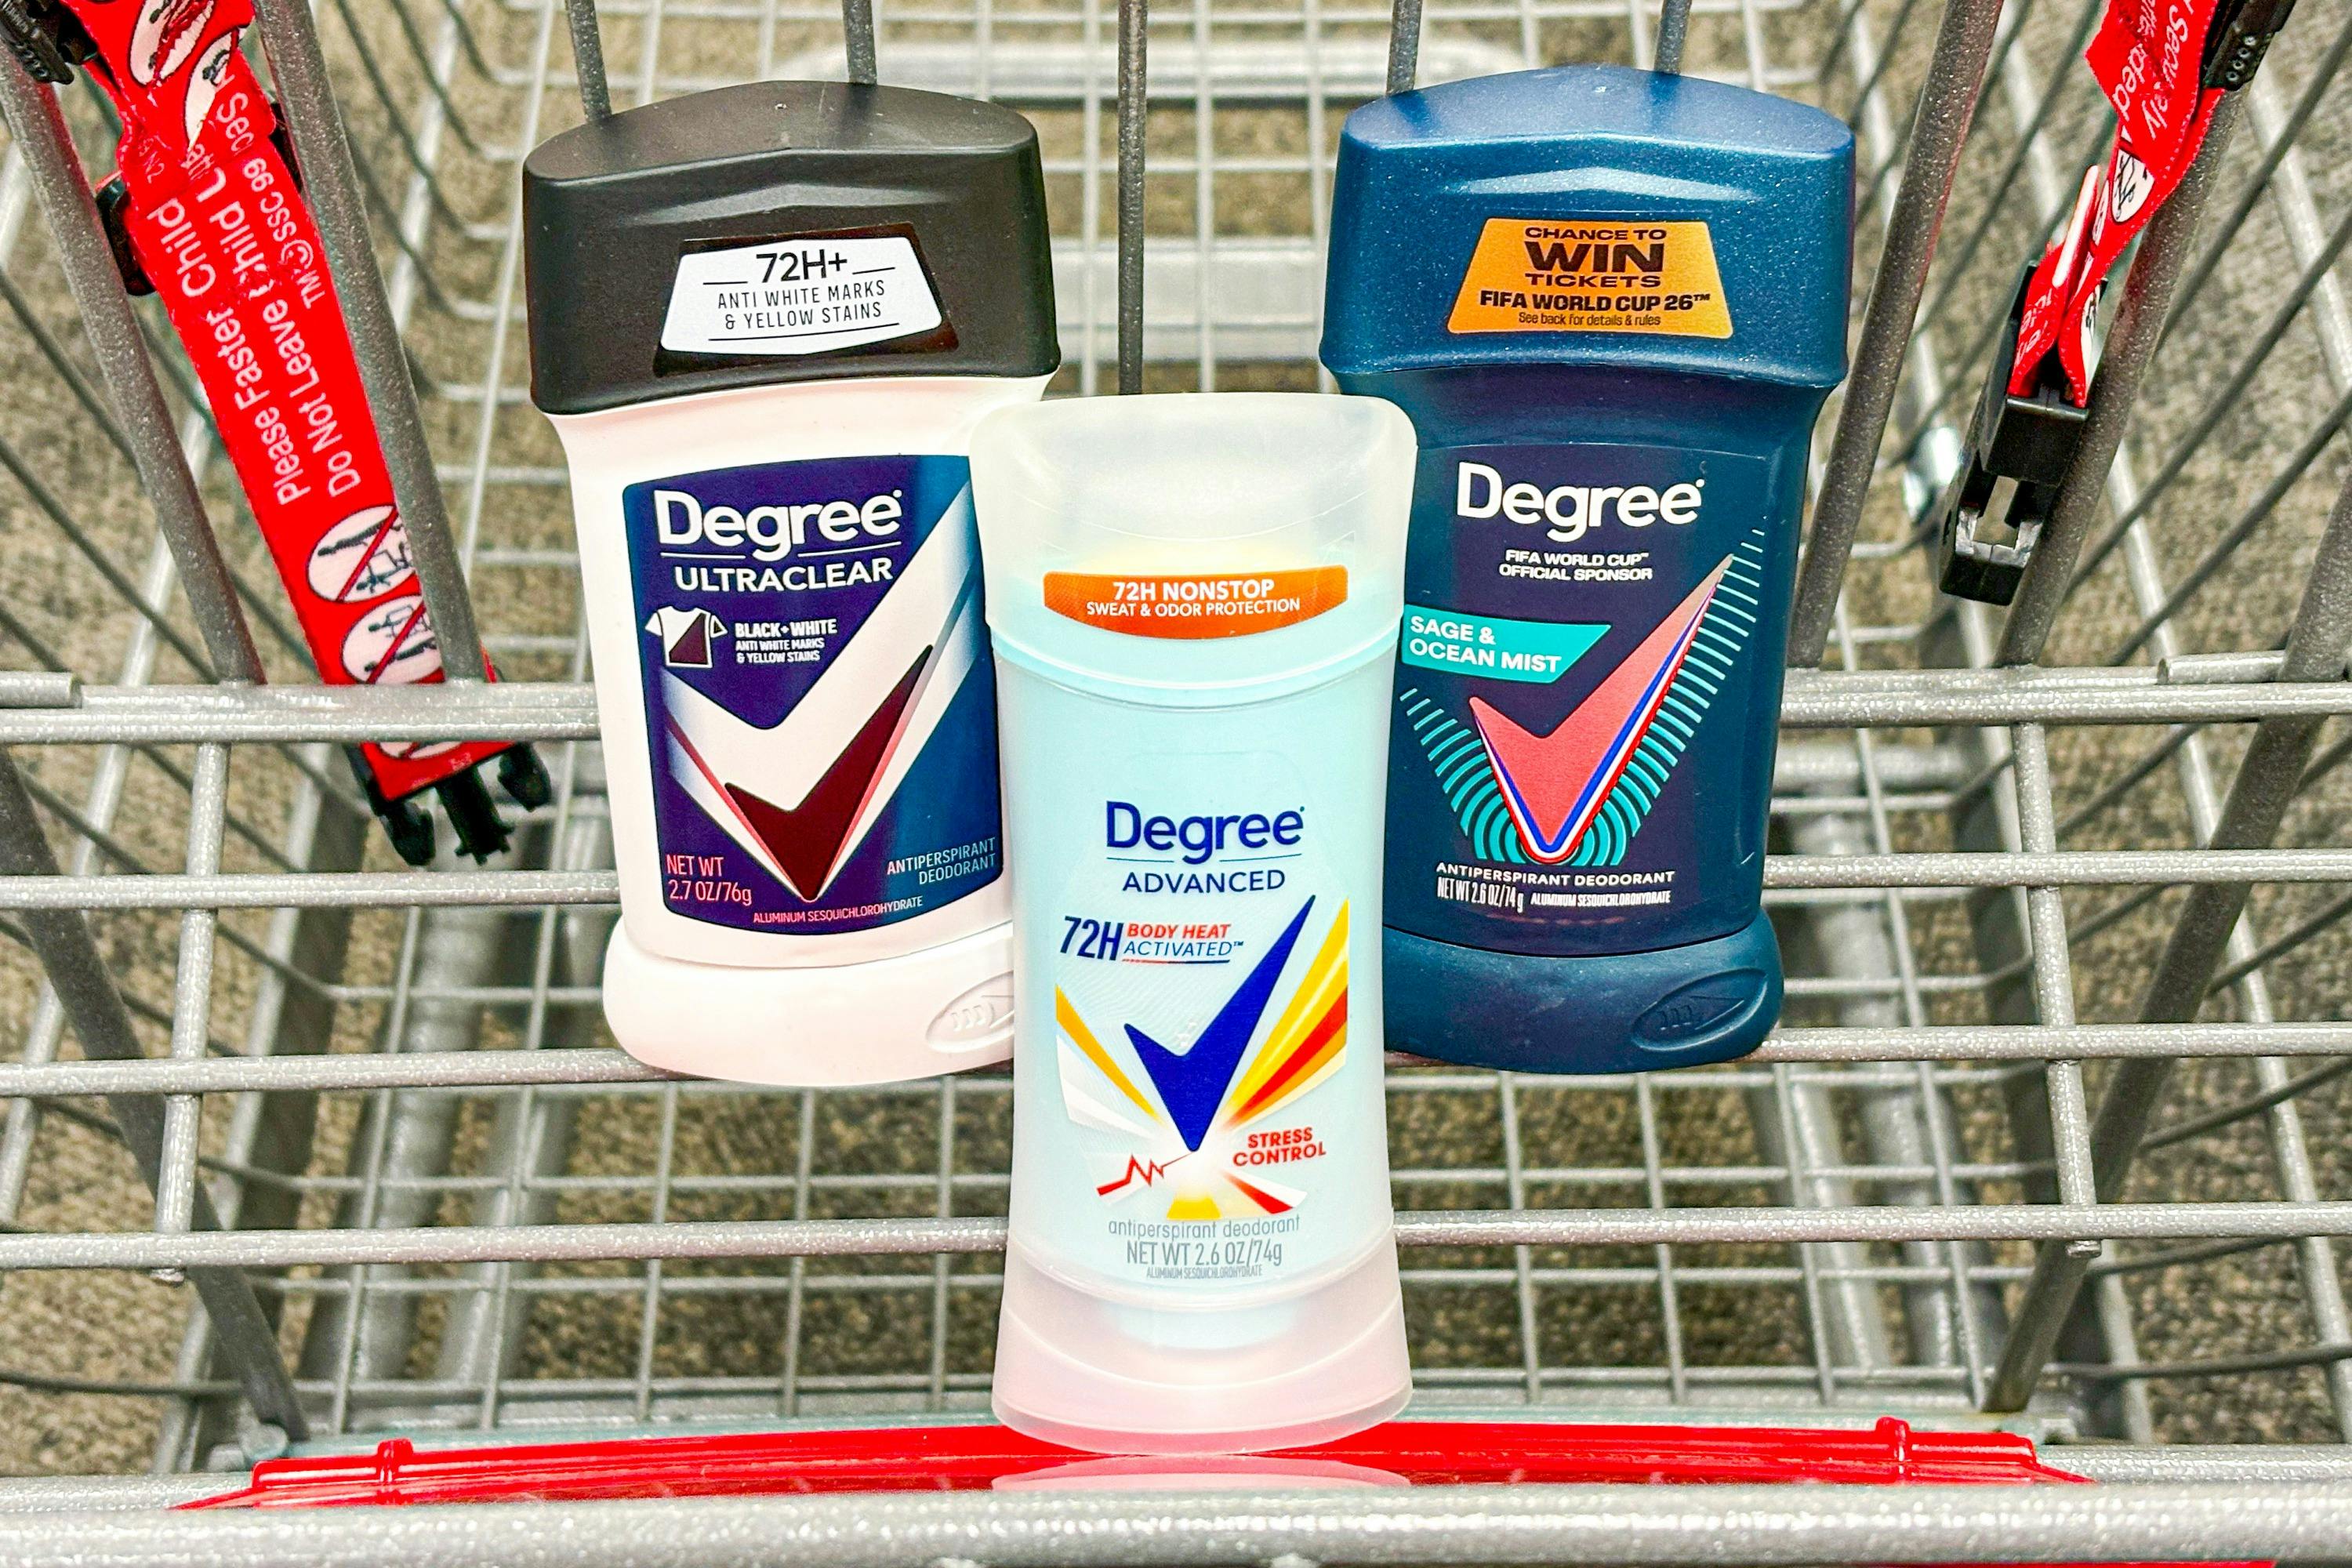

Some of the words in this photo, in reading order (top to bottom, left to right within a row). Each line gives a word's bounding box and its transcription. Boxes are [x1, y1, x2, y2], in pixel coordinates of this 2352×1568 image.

[242, 157, 274, 193] 99
[260, 191, 297, 242] SSC
[146, 197, 216, 297] Child
[1525, 227, 1628, 240] CHANCE
[1635, 229, 1667, 240] TO
[757, 249, 848, 283] 72H+
[1524, 241, 1665, 273] WIN
[717, 292, 757, 310] ANTI
[765, 287, 820, 307] WHITE
[828, 280, 885, 302] MARKS
[1524, 273, 1661, 289] TICKETS
[1480, 290, 1531, 309] FIFA
[1533, 296, 1610, 311] WORLD
[1615, 296, 1661, 312] CUP
[725, 314, 735, 329] &
[744, 310, 813, 328] YELLOW
[822, 302, 881, 324] STAINS
[1519, 312, 1540, 324] See
[1541, 314, 1566, 325] back
[1569, 314, 1584, 326] for
[1587, 314, 1622, 326] details
[1624, 314, 1632, 326] &
[1635, 314, 1661, 326] rules
[263, 299, 320, 397] Leave
[298, 393, 343, 453] Not
[254, 406, 311, 506] Please
[327, 450, 361, 497] Do
[1457, 461, 1705, 543] Degree
[654, 490, 902, 561] Degree
[1505, 549, 1541, 564] FIFA
[1544, 553, 1604, 566] WORLD
[675, 557, 893, 591] ULTRACLEAR
[1499, 564, 1570, 581] OFFICIAL
[1574, 567, 1653, 582] SPONSOR
[1113, 582, 1156, 601] 72H
[1163, 579, 1275, 601] NONSTOP
[1087, 601, 1134, 616] SWEAT
[1141, 604, 1150, 616] &
[1155, 602, 1202, 616] ODOR
[1207, 597, 1301, 615] PROTECTION
[1410, 615, 1474, 643] SAGE
[1479, 627, 1496, 644] &
[736, 640, 757, 651] ANTI
[759, 640, 790, 651] WHITE
[792, 637, 825, 650] MARKS
[737, 652, 745, 663] &
[746, 652, 786, 663] YELLOW
[787, 650, 820, 662] STAINS
[1409, 637, 1496, 667] OCEAN
[1501, 651, 1562, 673] MIST
[1106, 800, 1305, 865] Degree
[666, 855, 694, 876] NET
[698, 857, 724, 877] WT
[887, 837, 996, 875] ANTIPERSPIRANT
[918, 853, 995, 885] DEODORANT
[1123, 869, 1286, 894] ADVANCED
[1436, 862, 1570, 886] ANTIPERSPIRANT
[1574, 871, 1675, 886] DEODORANT
[669, 880, 691, 900] 2.7
[695, 880, 753, 906] OZ/76g
[1437, 877, 1455, 899] NET
[1456, 880, 1471, 902] WT
[1471, 881, 1486, 904] 2.6
[753, 911, 806, 924] ALUMINUM
[807, 895, 923, 923] SESQUICHLOROHYDRATE
[1060, 916, 1124, 961] 72H
[1127, 924, 1178, 938] BODY
[1183, 924, 1231, 938] HEAT
[1247, 1127, 1313, 1149] STRESS
[1232, 1141, 1327, 1167] CONTROL
[1108, 1219, 1216, 1241] antiperspirant
[1223, 1214, 1300, 1238] deodorant
[1127, 1240, 1158, 1265] NET
[1161, 1242, 1190, 1266] WT
[1196, 1242, 1220, 1265] 2.6
[1225, 1238, 1282, 1267] OZ/74g
[1146, 1266, 1183, 1279] ALUMINUM
